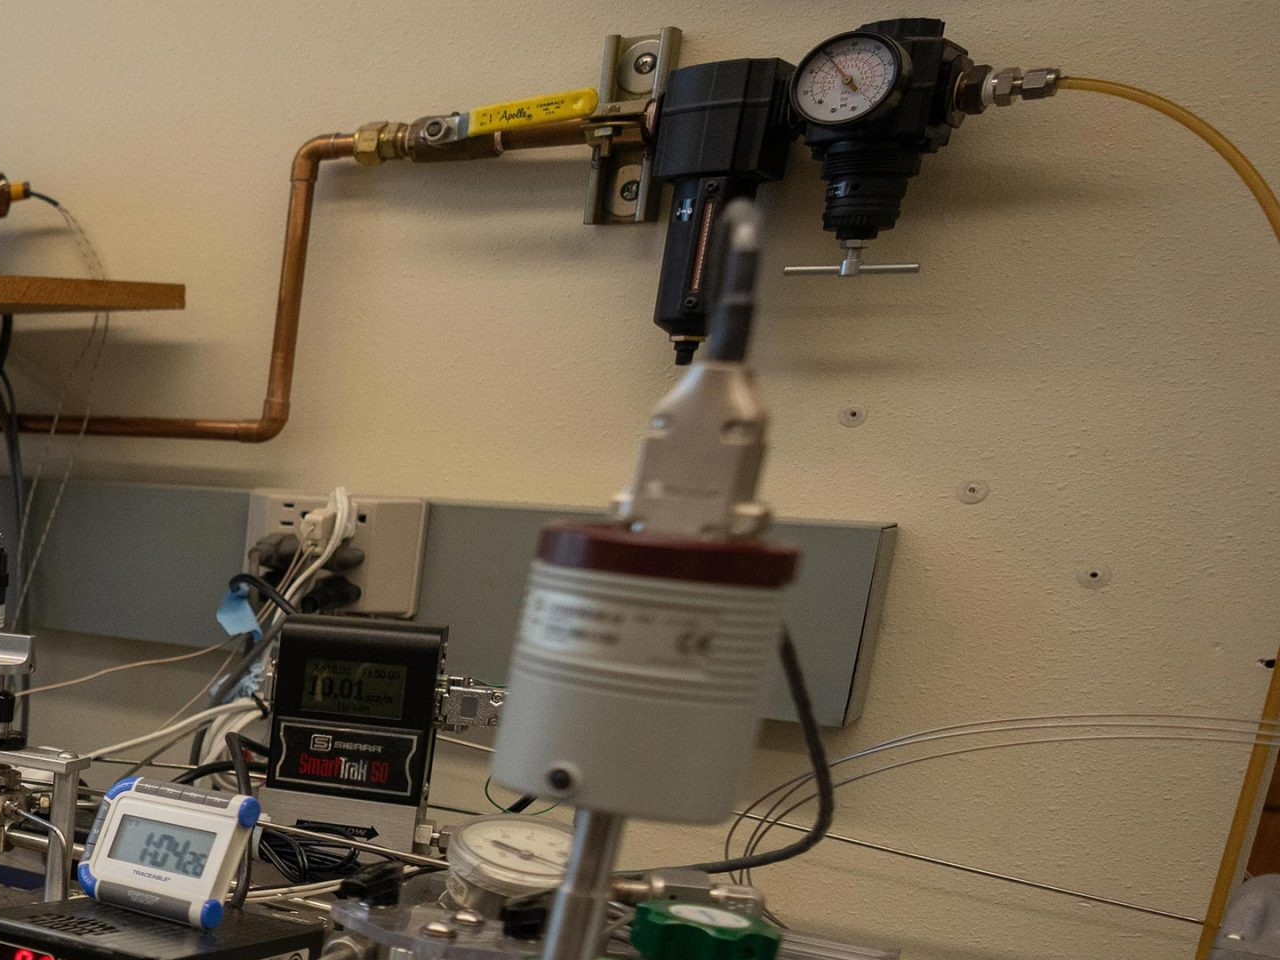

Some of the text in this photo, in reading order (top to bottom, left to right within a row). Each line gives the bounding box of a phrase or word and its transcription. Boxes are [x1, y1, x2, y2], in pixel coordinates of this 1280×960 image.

[308, 675, 365, 700] 10.01
[334, 741, 382, 753] SIERRA
[299, 754, 368, 781] SmartTrak
[132, 869, 169, 882] TRACEABLE
